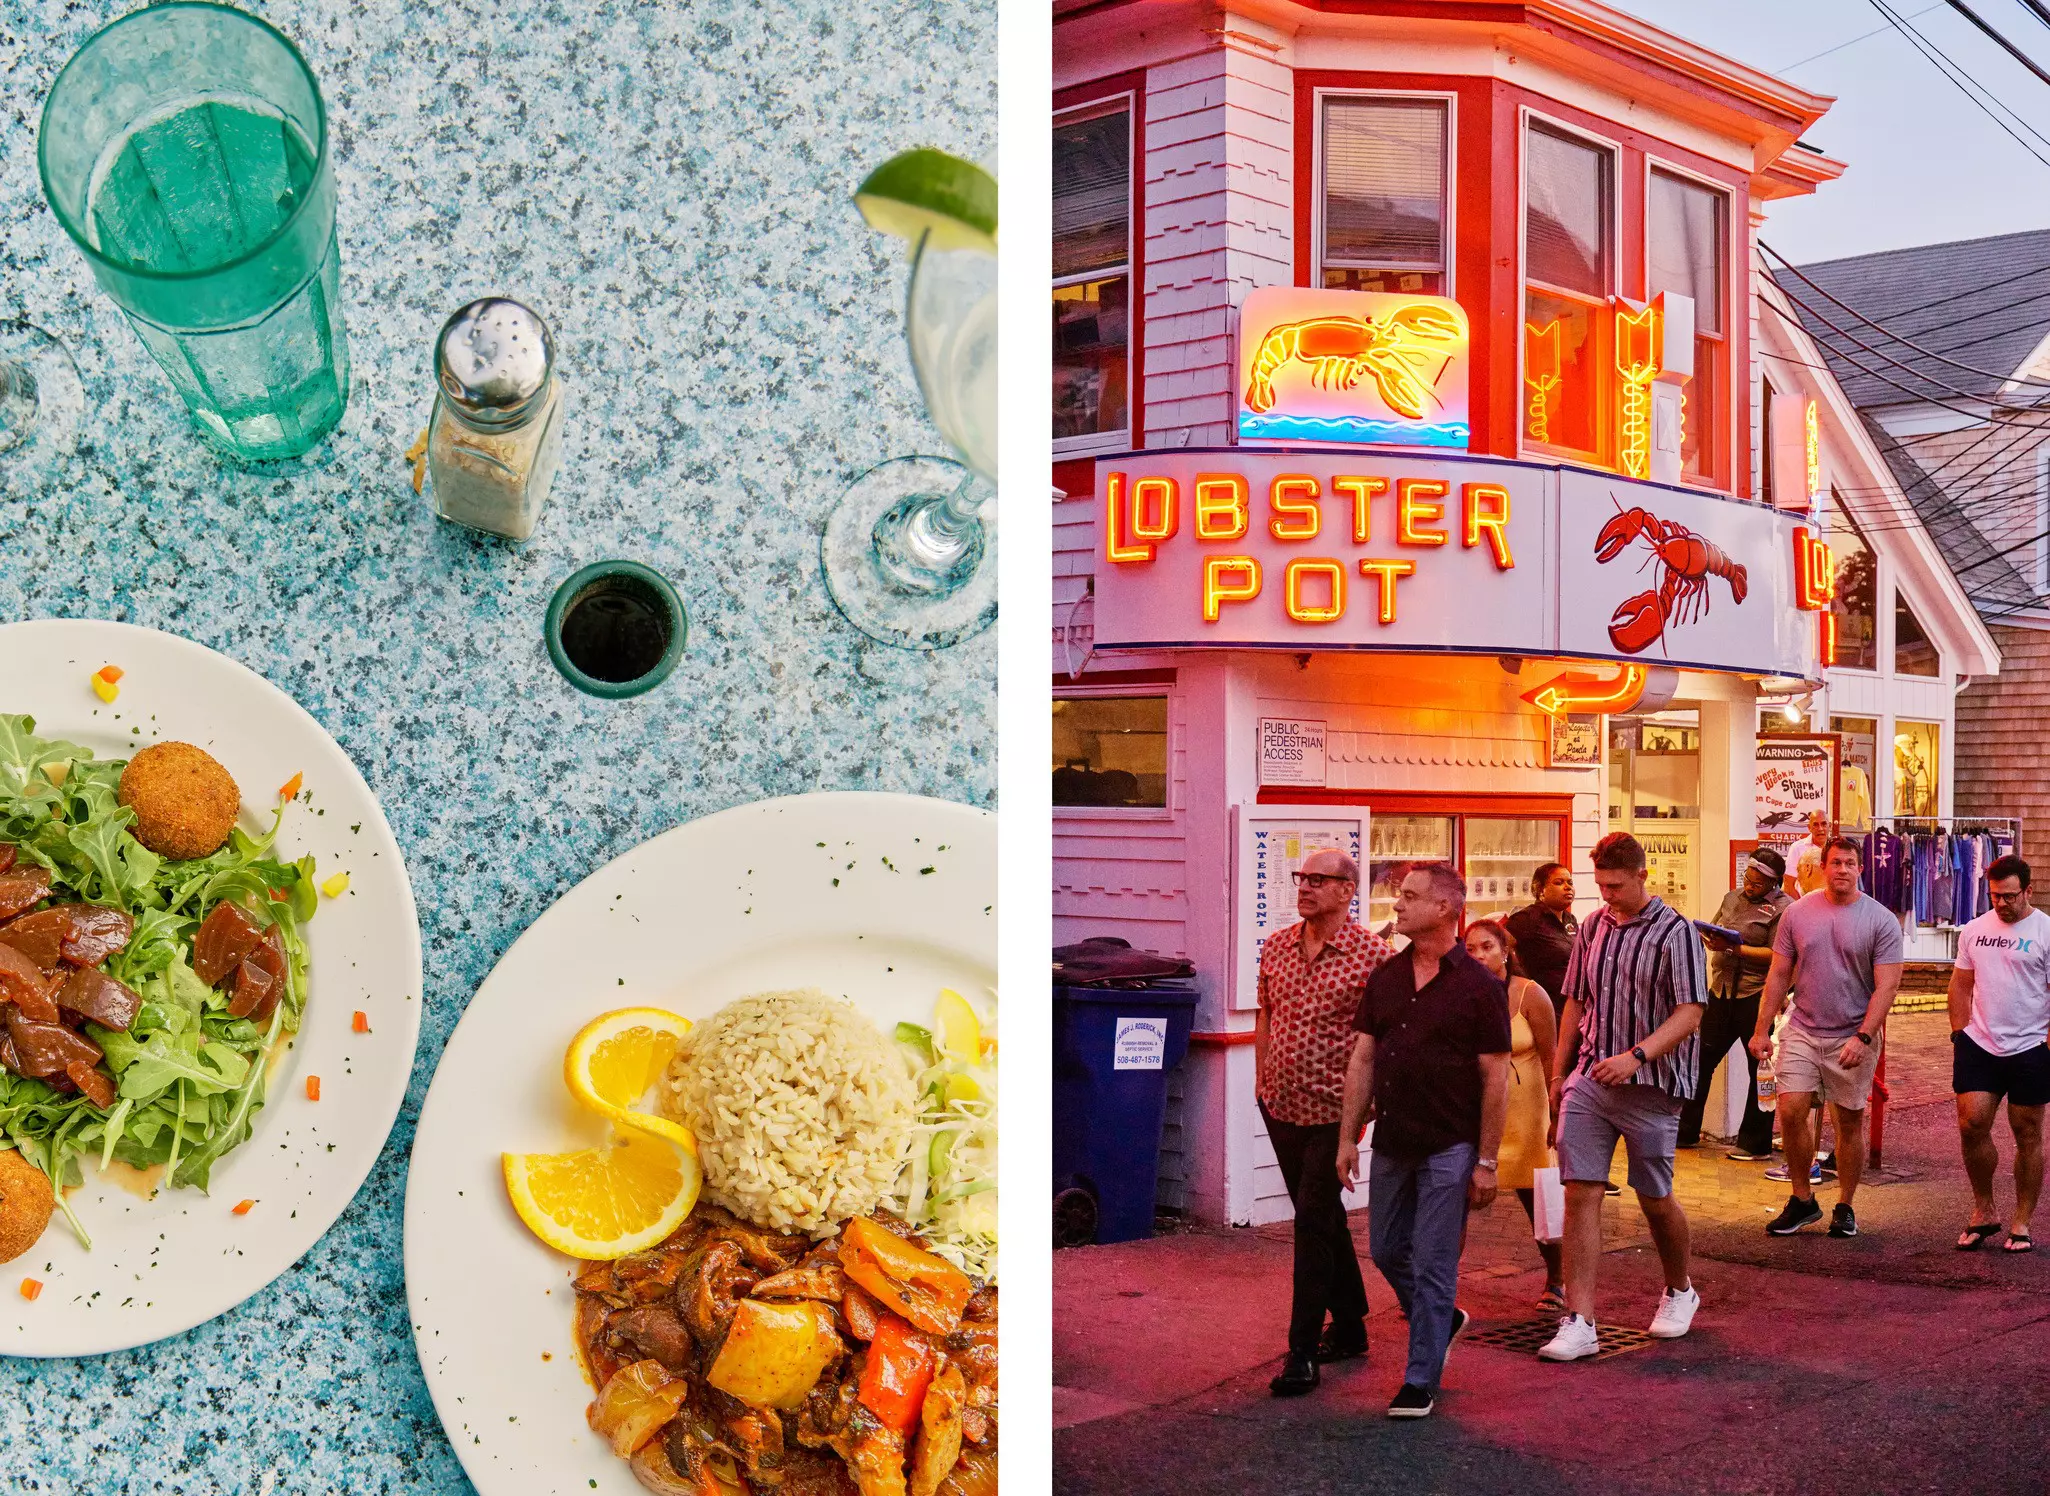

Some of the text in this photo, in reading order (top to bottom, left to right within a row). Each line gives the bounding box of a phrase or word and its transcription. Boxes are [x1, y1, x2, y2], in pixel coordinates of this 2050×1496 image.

[1107, 472, 1515, 570] LOBSTER
[1203, 555, 1416, 624] POT
[1264, 722, 1300, 735] PUBLIC
[1264, 735, 1323, 748] PEDESTRIAN
[1264, 748, 1303, 760] ACCESS
[1756, 748, 1802, 758] WARNING
[1764, 771, 1787, 791] Week
[1781, 779, 1814, 792] Shark
[1793, 786, 1824, 800] Week!
[1765, 796, 1783, 806] Cape
[1770, 833, 1803, 841] SHARK
[1255, 831, 1269, 927] WATERFRONT
[1975, 935, 2016, 949] Hurley
[1116, 1026, 1130, 1044] JAMES
[1117, 1056, 1161, 1064] 508-487-1578
